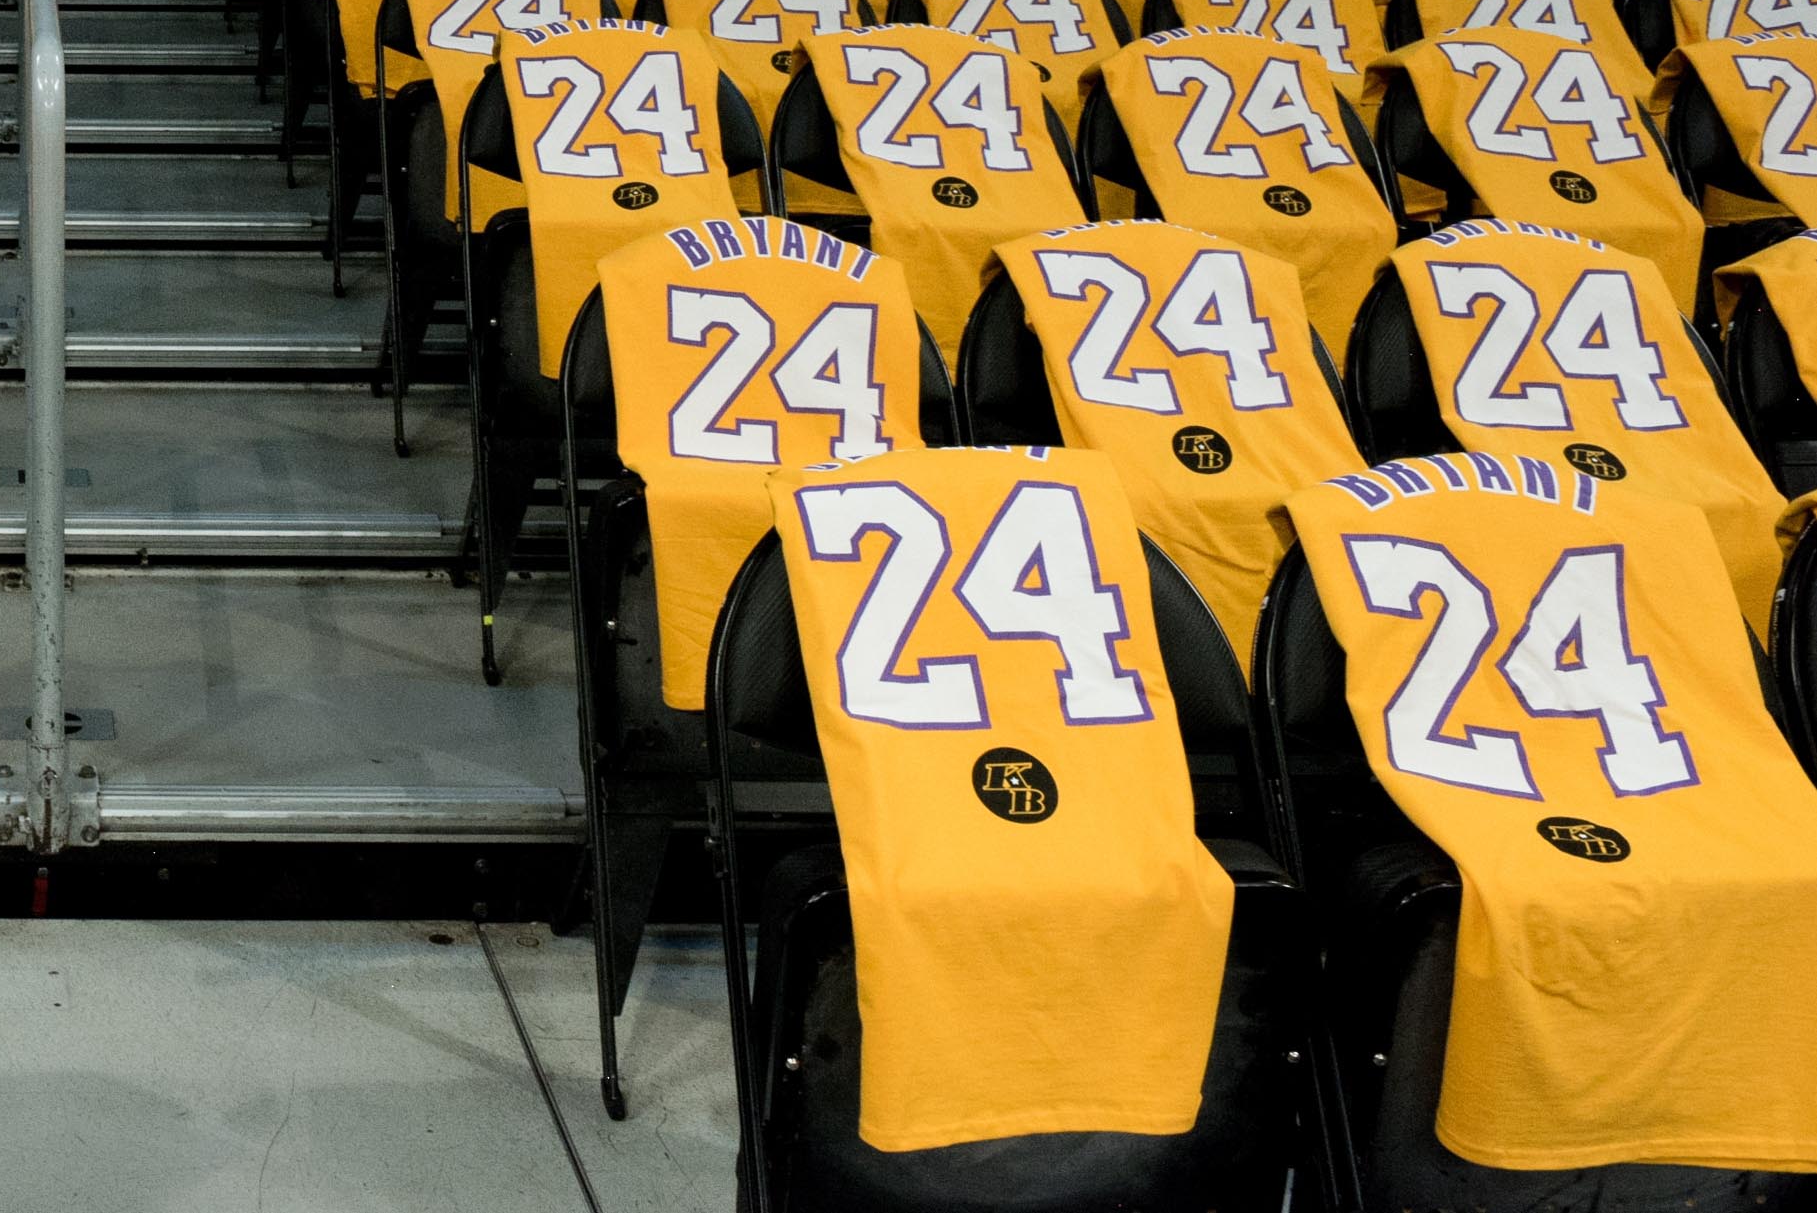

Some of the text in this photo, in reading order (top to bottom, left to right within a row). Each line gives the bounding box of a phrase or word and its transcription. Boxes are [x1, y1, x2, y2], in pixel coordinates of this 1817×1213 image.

[518, 52, 708, 178] 24
[843, 46, 1032, 171] 24
[1147, 48, 1356, 178] 24
[1439, 42, 1645, 163] 24
[1734, 56, 1817, 176] 2
[665, 216, 878, 282] BRYANT
[668, 286, 892, 464] 24
[1035, 250, 1292, 415] 24
[1428, 262, 1688, 432] 24
[1179, 434, 1224, 472] KB
[1323, 452, 1600, 515] BRYANT
[1570, 447, 1620, 478] KB
[795, 480, 1154, 730] 24
[1342, 534, 1700, 801] 24
[983, 762, 1046, 816] KB
[1552, 823, 1623, 857] KB
